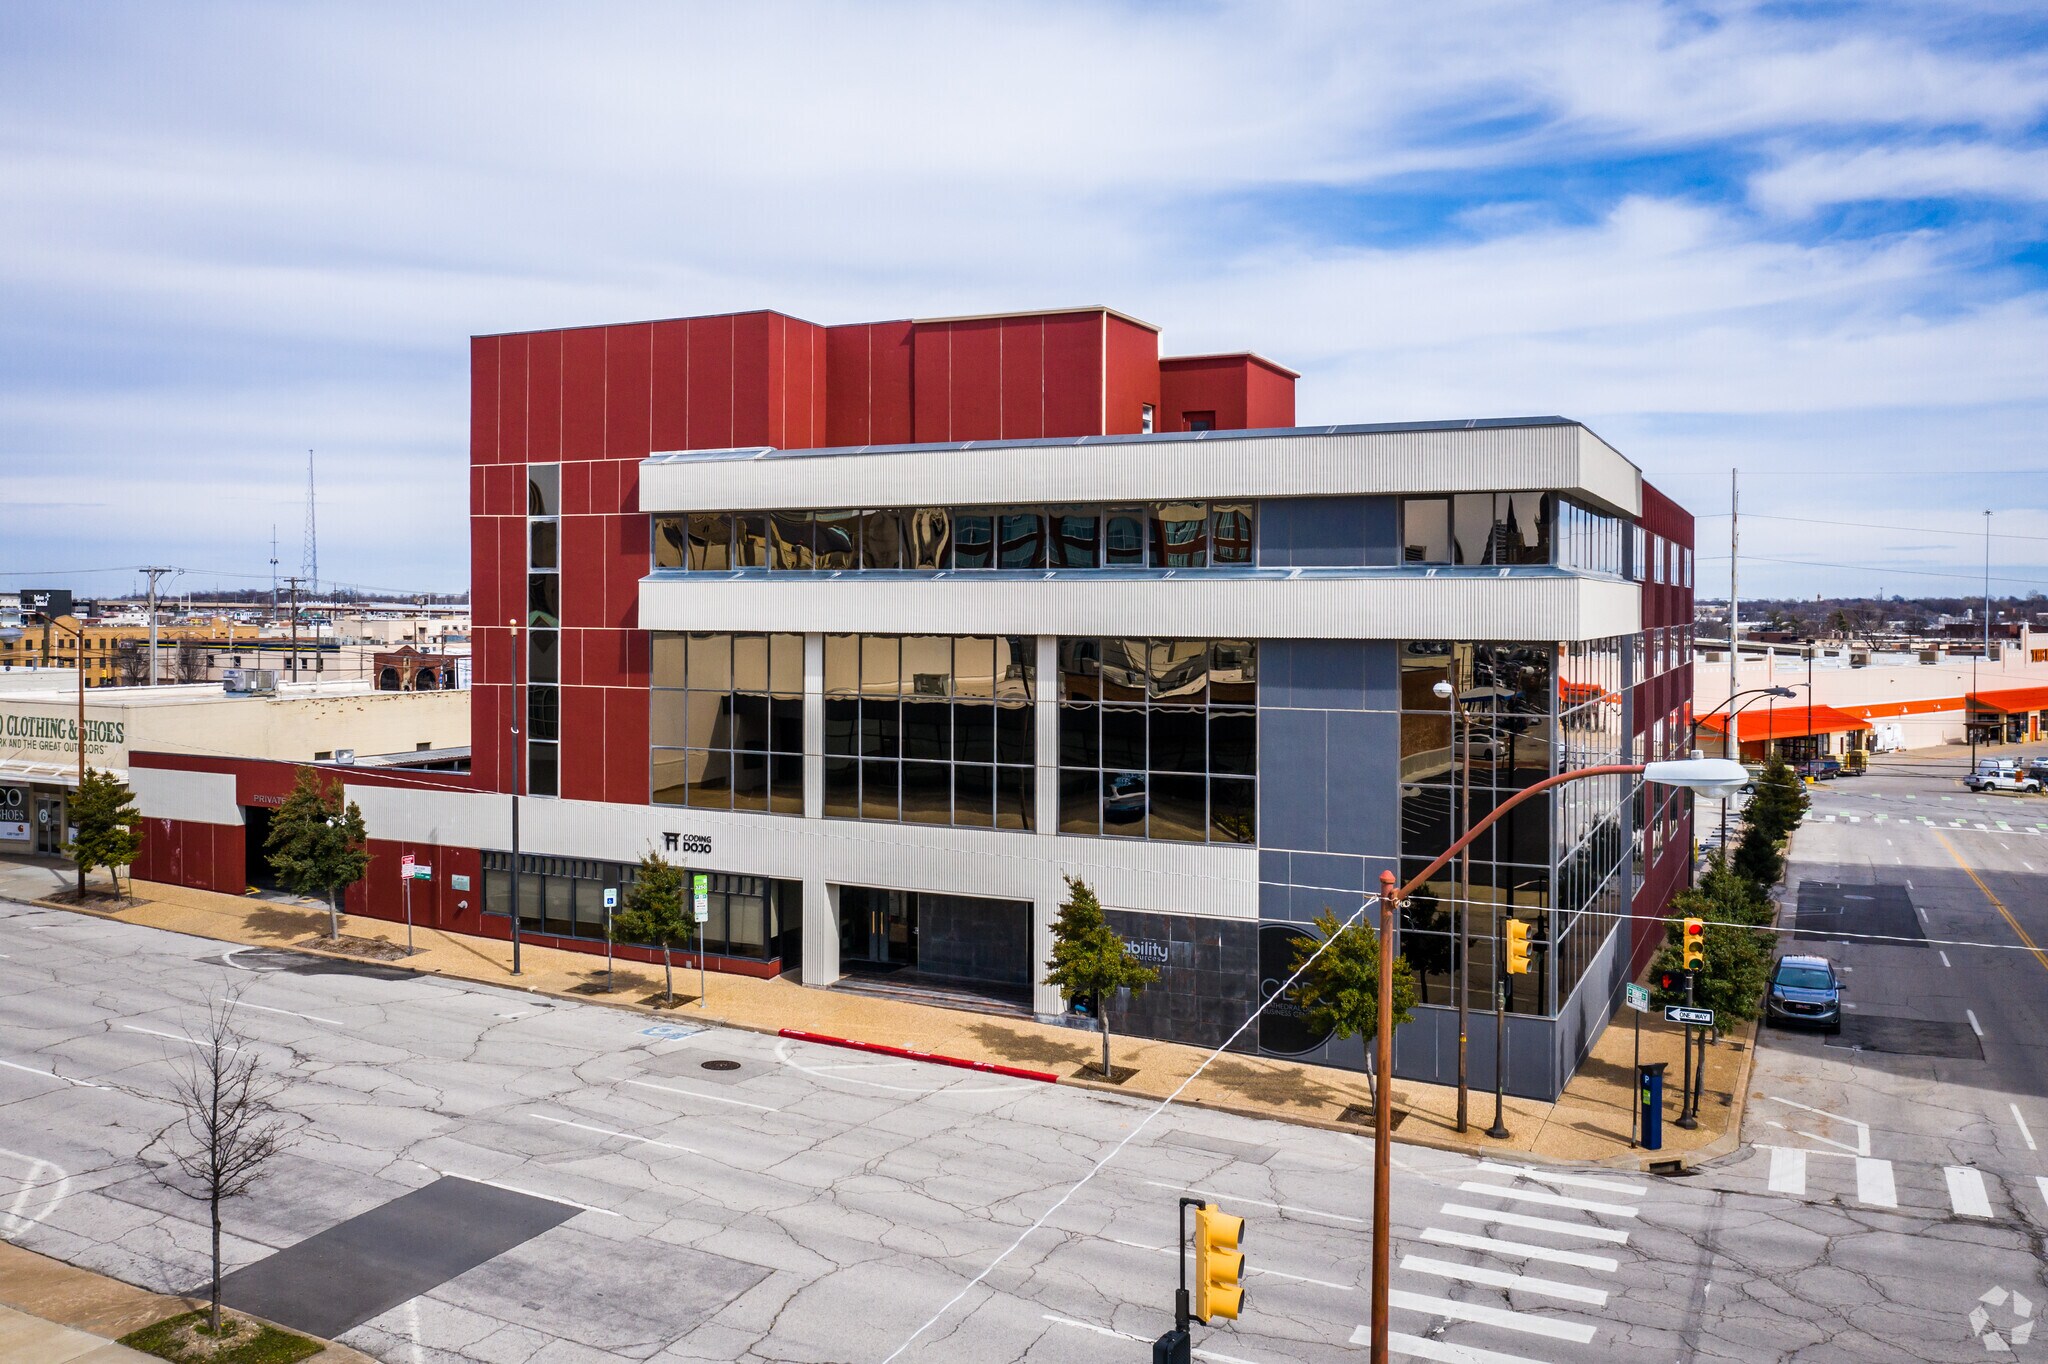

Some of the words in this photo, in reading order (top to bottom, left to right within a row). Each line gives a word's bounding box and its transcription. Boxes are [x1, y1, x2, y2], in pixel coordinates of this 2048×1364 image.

[7, 715, 66, 739] CLOTHING
[68, 719, 78, 741] &
[9, 739, 21, 748] AND
[23, 740, 37, 750] THE
[39, 740, 61, 751] GREAT
[253, 794, 286, 804] PRIVATE
[0, 809, 24, 820] HOES
[683, 834, 711, 843] CODING
[683, 842, 711, 854] DOJO
[1265, 1002, 1301, 1012] ATHEDRAL
[1644, 1075, 1649, 1083] P
